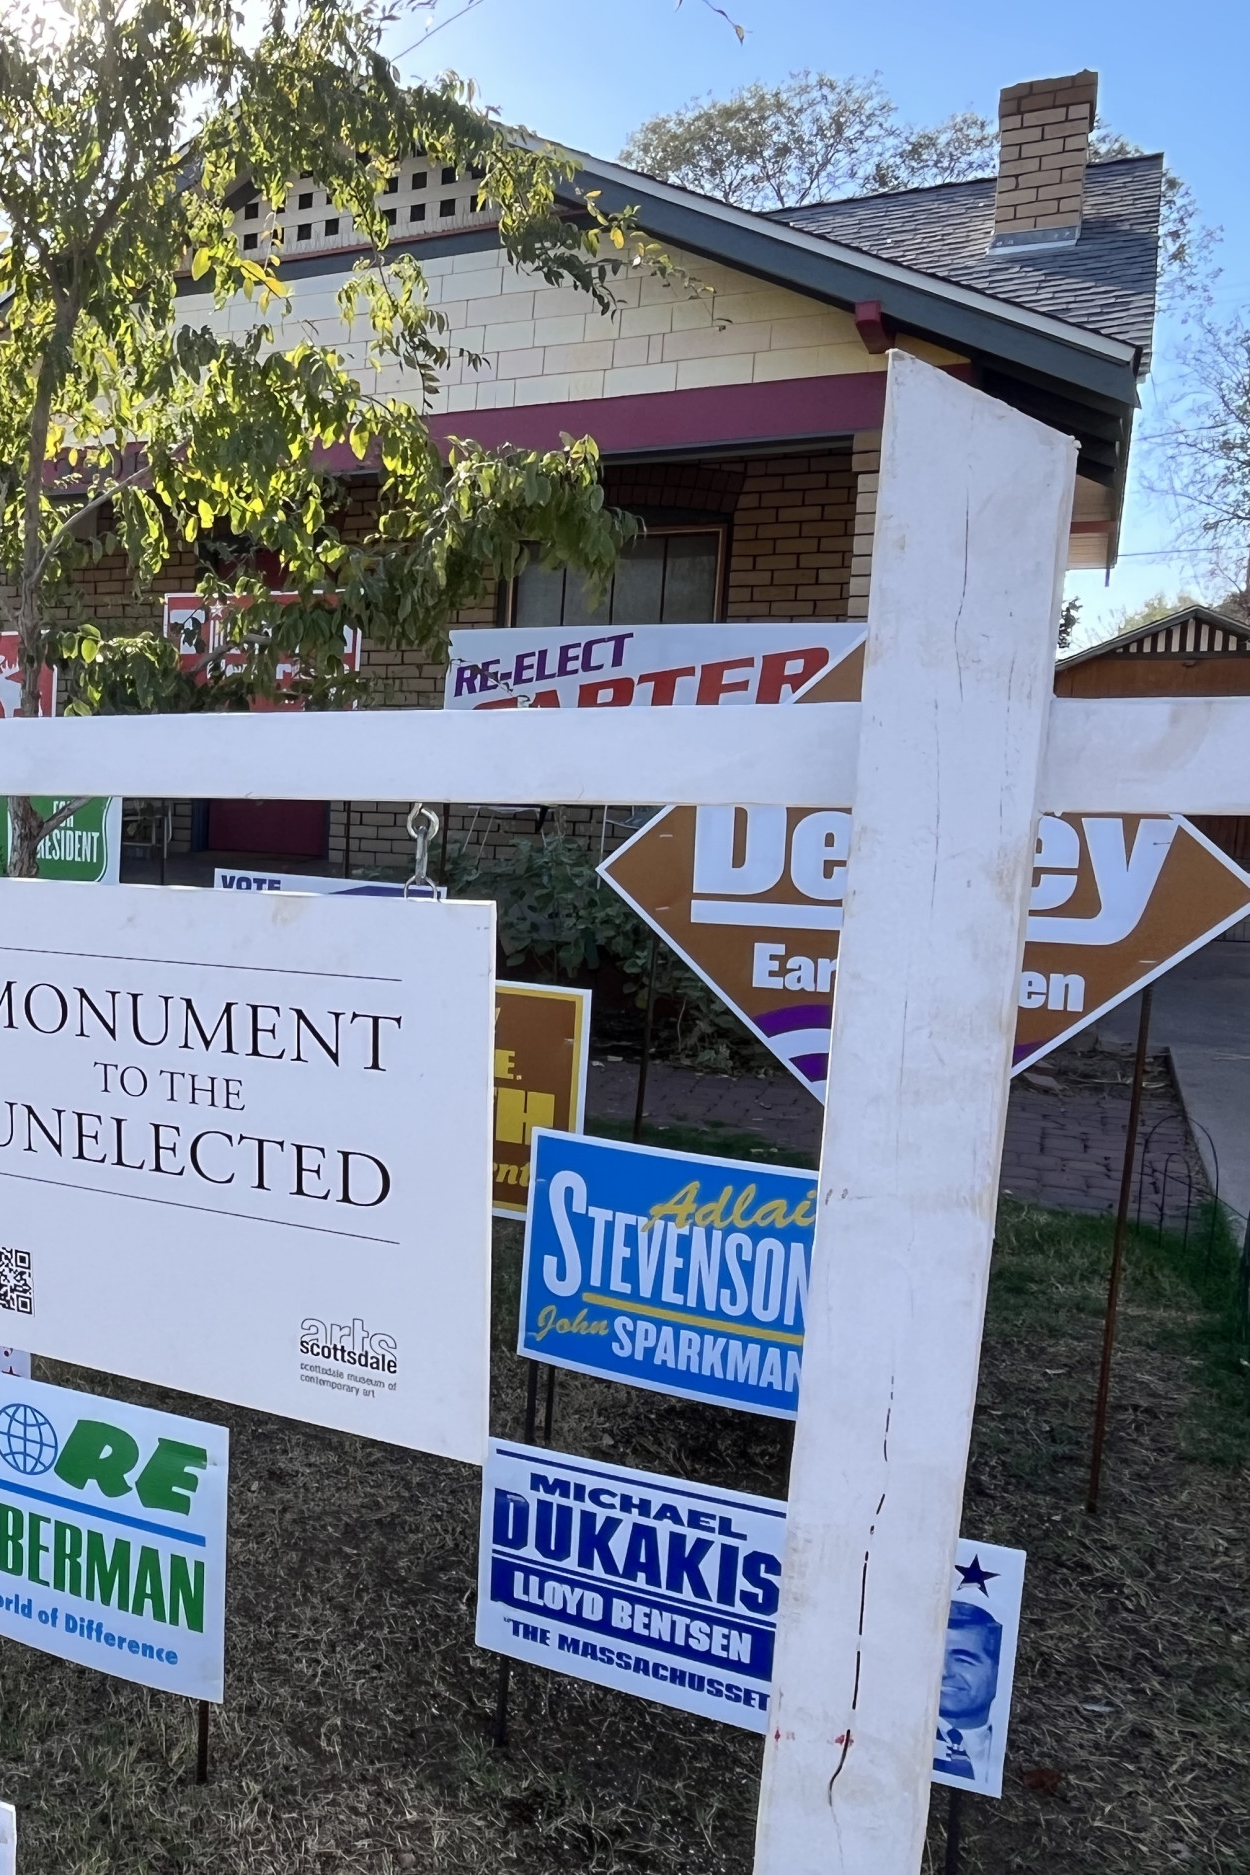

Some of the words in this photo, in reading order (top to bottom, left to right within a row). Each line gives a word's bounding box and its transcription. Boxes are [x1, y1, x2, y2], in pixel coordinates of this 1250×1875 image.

[453, 632, 634, 698] RE-ELECT
[221, 874, 282, 891] VOTE
[752, 942, 839, 994] Ear
[93, 1061, 148, 1098] TO
[159, 1068, 247, 1112] THE
[641, 1180, 817, 1233] Adlai
[299, 1340, 398, 1375] scottsdale
[300, 1317, 398, 1362] arts
[536, 1304, 610, 1342] John
[611, 1314, 803, 1393] SPARKMAN
[300, 1362, 345, 1380] scottsdale
[346, 1373, 386, 1389] museum
[388, 1382, 398, 1392] of
[300, 1373, 360, 1397] contemporary
[362, 1388, 376, 1398] art
[529, 1472, 748, 1542] MICHAEL
[492, 1487, 782, 1617] DUKAKIS
[37, 1606, 59, 1629] of
[64, 1612, 179, 1667] Difference
[513, 1571, 605, 1622] LLOYD
[611, 1597, 753, 1665] BENTSEN
[557, 1633, 771, 1712] MASSACHUSSET
